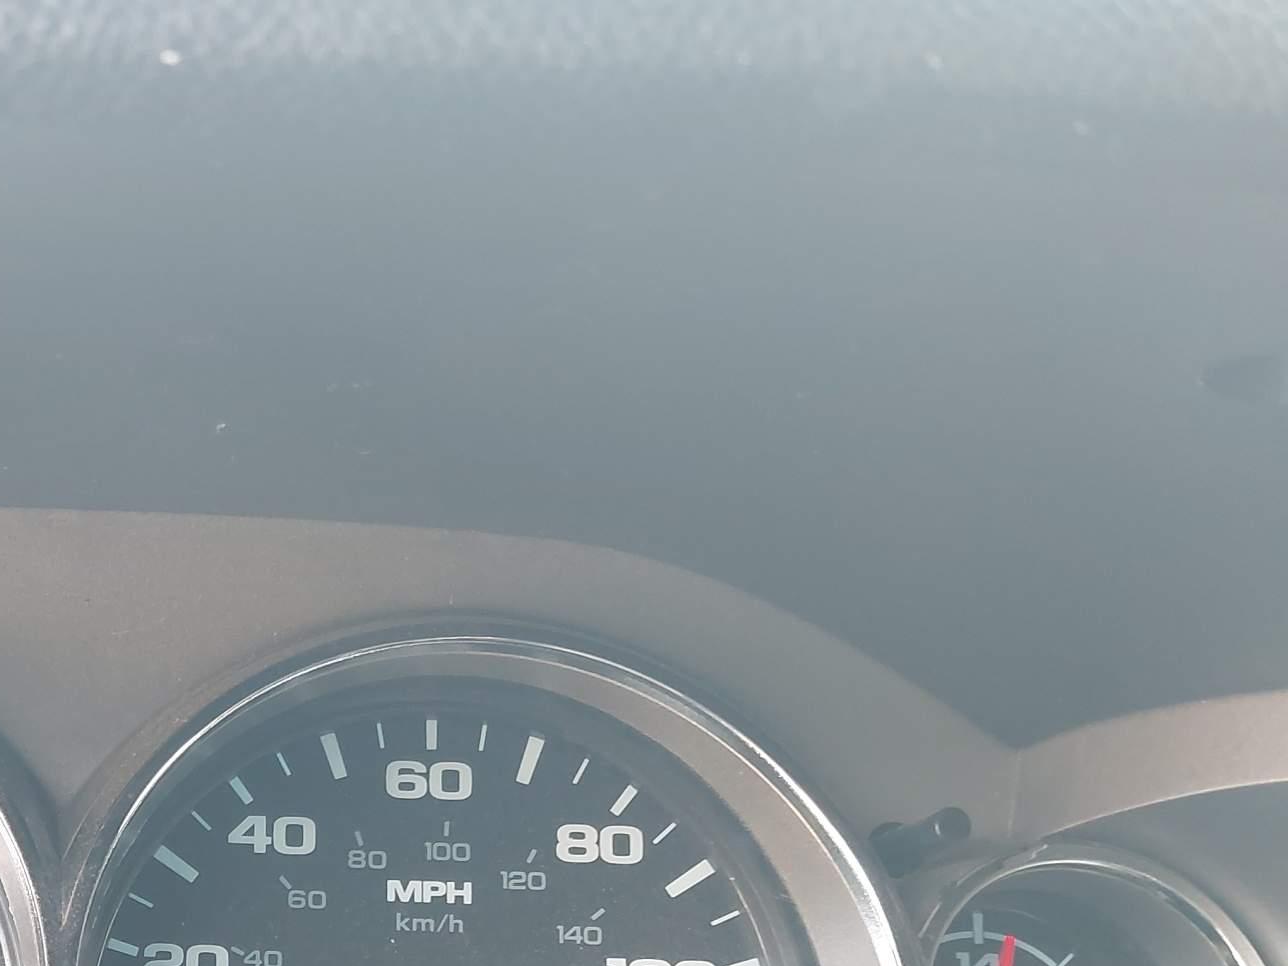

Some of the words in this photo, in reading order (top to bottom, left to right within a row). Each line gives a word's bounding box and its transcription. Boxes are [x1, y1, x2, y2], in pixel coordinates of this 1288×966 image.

[386, 761, 472, 799] 60
[227, 816, 316, 854] 40
[556, 825, 644, 864] 80
[347, 849, 387, 869] 80
[425, 842, 471, 862] 100
[501, 872, 546, 891] 120
[287, 890, 327, 910] 60
[386, 880, 473, 904] MPH
[395, 914, 464, 934] km/h
[556, 925, 603, 945] 140
